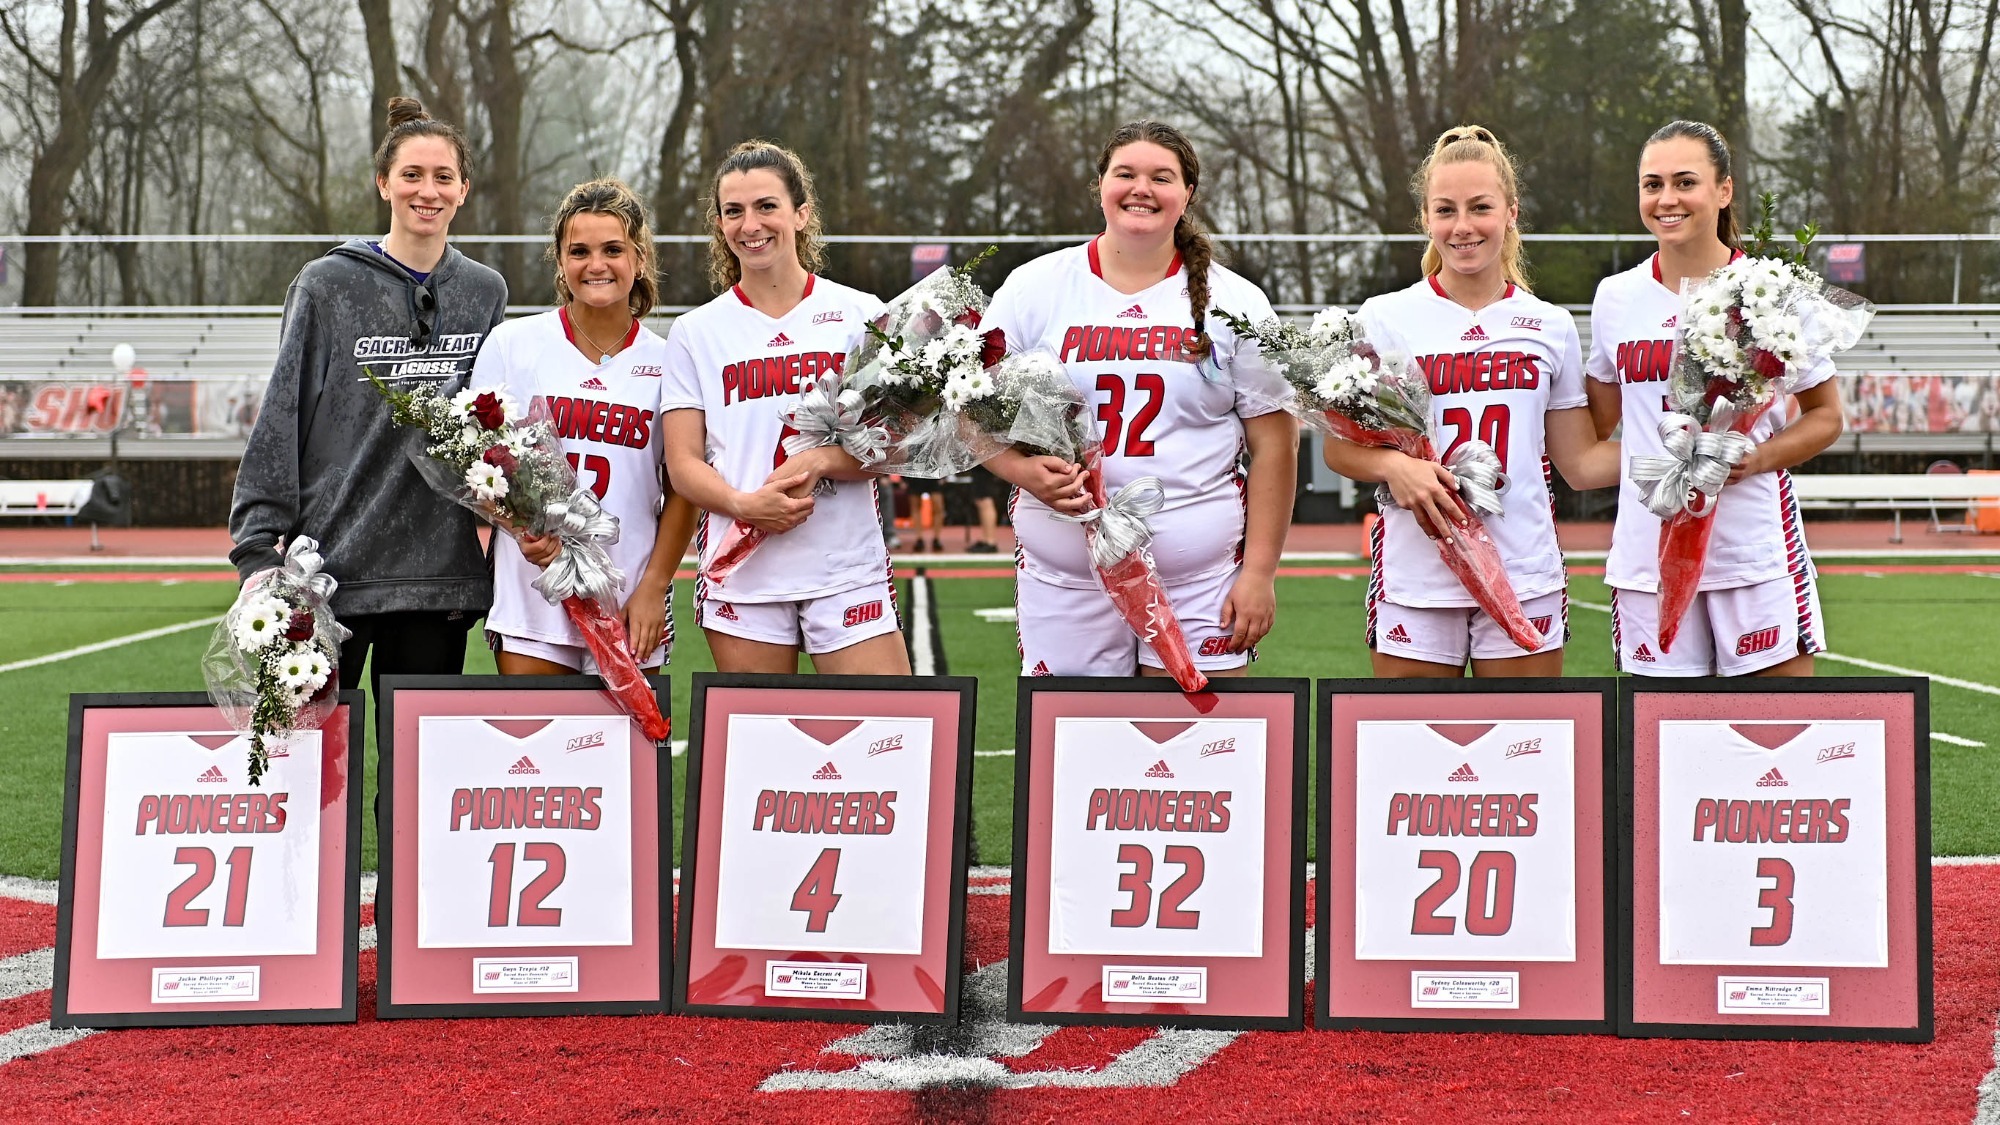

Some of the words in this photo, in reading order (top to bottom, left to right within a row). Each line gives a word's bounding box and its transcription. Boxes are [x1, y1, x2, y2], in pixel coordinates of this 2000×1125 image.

[1117, 311, 1148, 319] adidas
[1511, 317, 1542, 328] NEC
[353, 336, 427, 358] SACR
[767, 339, 795, 348] adidas
[390, 361, 457, 376] LACROSSE
[1616, 340, 1673, 385] PION
[1415, 351, 1541, 395] IONEERS
[579, 383, 607, 391] adidas
[26, 383, 128, 432] SHU
[1095, 373, 1166, 457] 32
[715, 611, 739, 621] adidas
[843, 600, 883, 628] SHU
[1198, 635, 1234, 656] SH
[1386, 633, 1412, 643] adidas
[1736, 625, 1780, 657] SHU
[1632, 654, 1656, 662] adidas
[566, 732, 604, 750] NEC
[868, 734, 903, 754] NEC
[1200, 738, 1235, 755] NEC
[1506, 738, 1541, 756] NEC
[1817, 742, 1855, 760] NEC
[1448, 774, 1479, 782] adidas
[1756, 779, 1788, 787] adidas
[136, 793, 288, 835] PIONEERS
[449, 787, 603, 831] PIONEERS
[753, 789, 897, 835] PIONEERS
[1086, 788, 1232, 833] PIONEERS
[1387, 793, 1539, 837] PIONEERS
[1693, 798, 1851, 843] PIONEERS
[163, 846, 254, 927] 21
[487, 842, 567, 927] 12
[790, 848, 842, 933] 4
[1110, 844, 1205, 930] 32
[1411, 850, 1517, 936] 20
[1750, 858, 1795, 946] 3
[163, 982, 180, 990] SHU
[484, 972, 501, 980] SHU
[777, 975, 792, 983] SHU
[1113, 980, 1130, 989] SHU
[1422, 987, 1439, 996] SHU
[1729, 991, 1747, 1000] SHU
